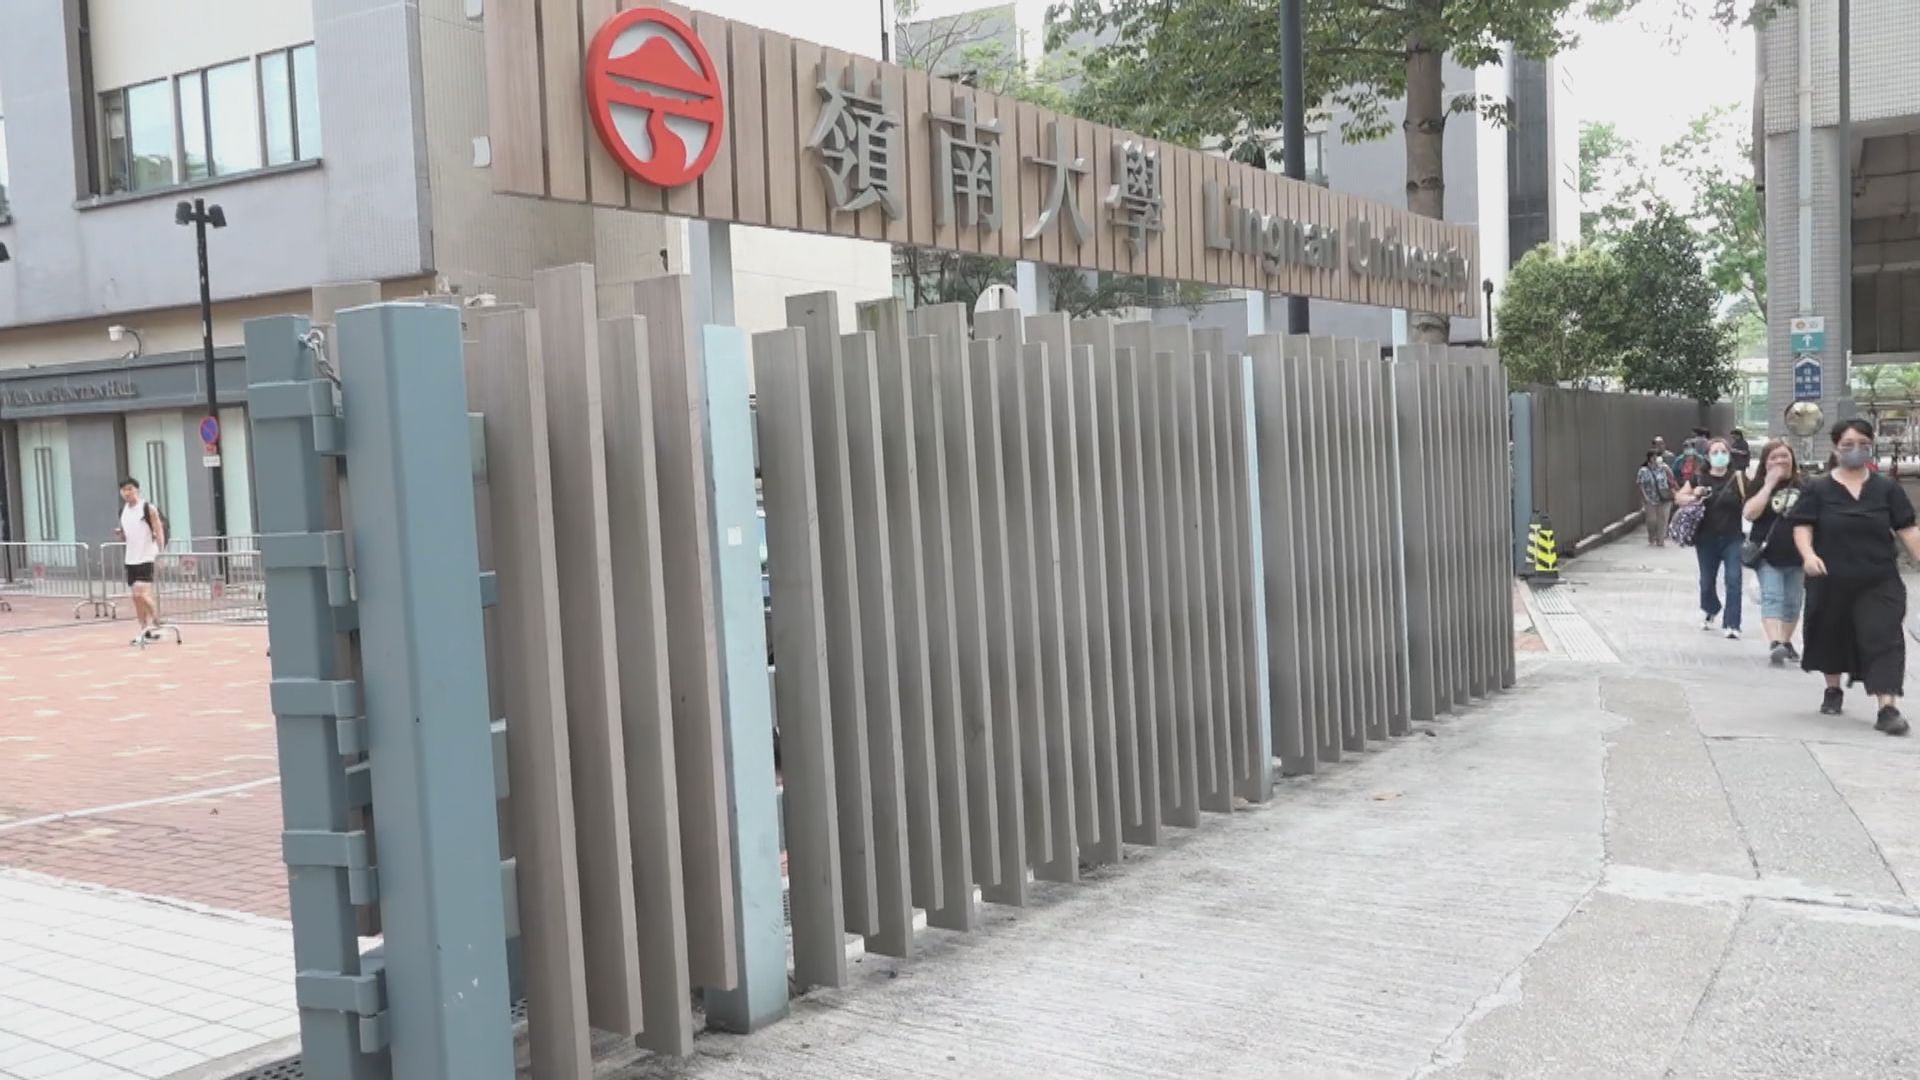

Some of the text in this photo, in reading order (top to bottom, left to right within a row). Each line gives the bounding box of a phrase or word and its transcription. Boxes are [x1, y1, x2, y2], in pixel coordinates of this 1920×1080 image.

[805, 58, 1164, 259] 嶺南大學
[1203, 179, 1472, 304] Lingnan University
